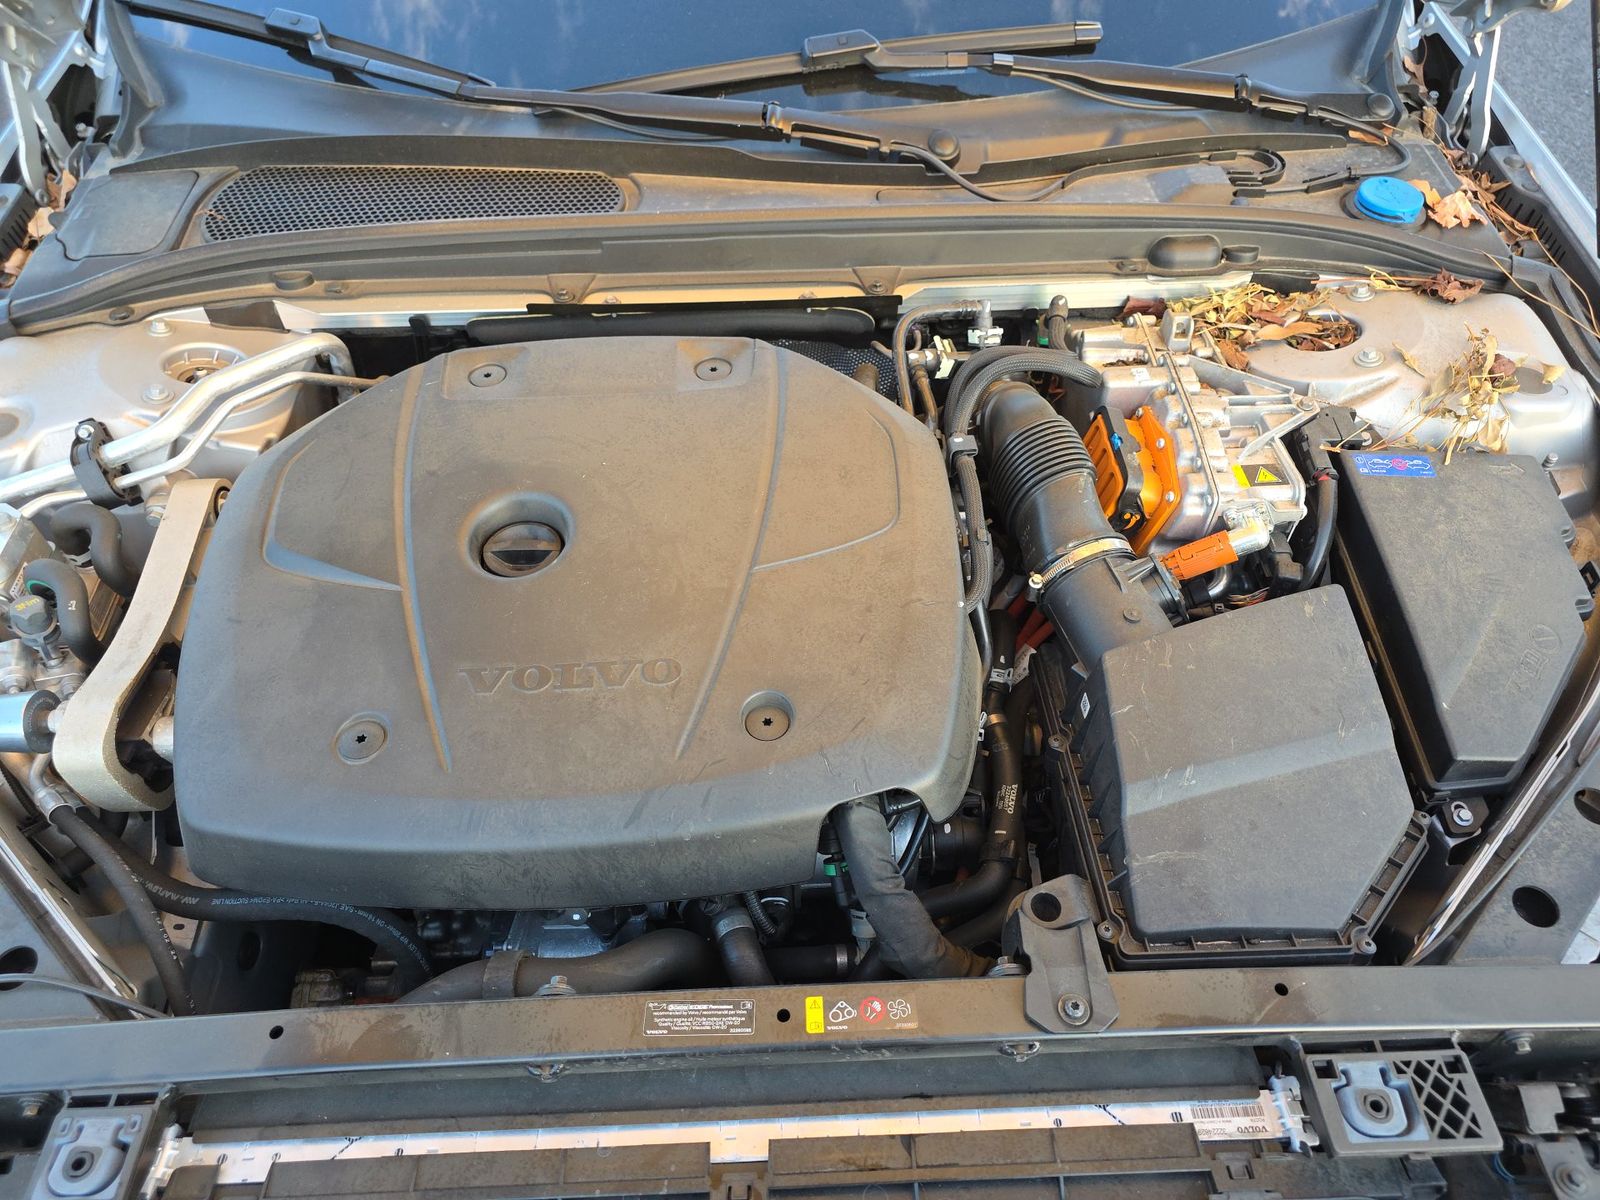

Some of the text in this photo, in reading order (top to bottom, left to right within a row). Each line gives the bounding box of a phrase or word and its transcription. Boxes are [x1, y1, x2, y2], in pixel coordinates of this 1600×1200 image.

[456, 657, 682, 696] VOLVO
[1008, 784, 1018, 814] VOLVO
[210, 897, 225, 905] LINE
[225, 897, 249, 905] SUCTION
